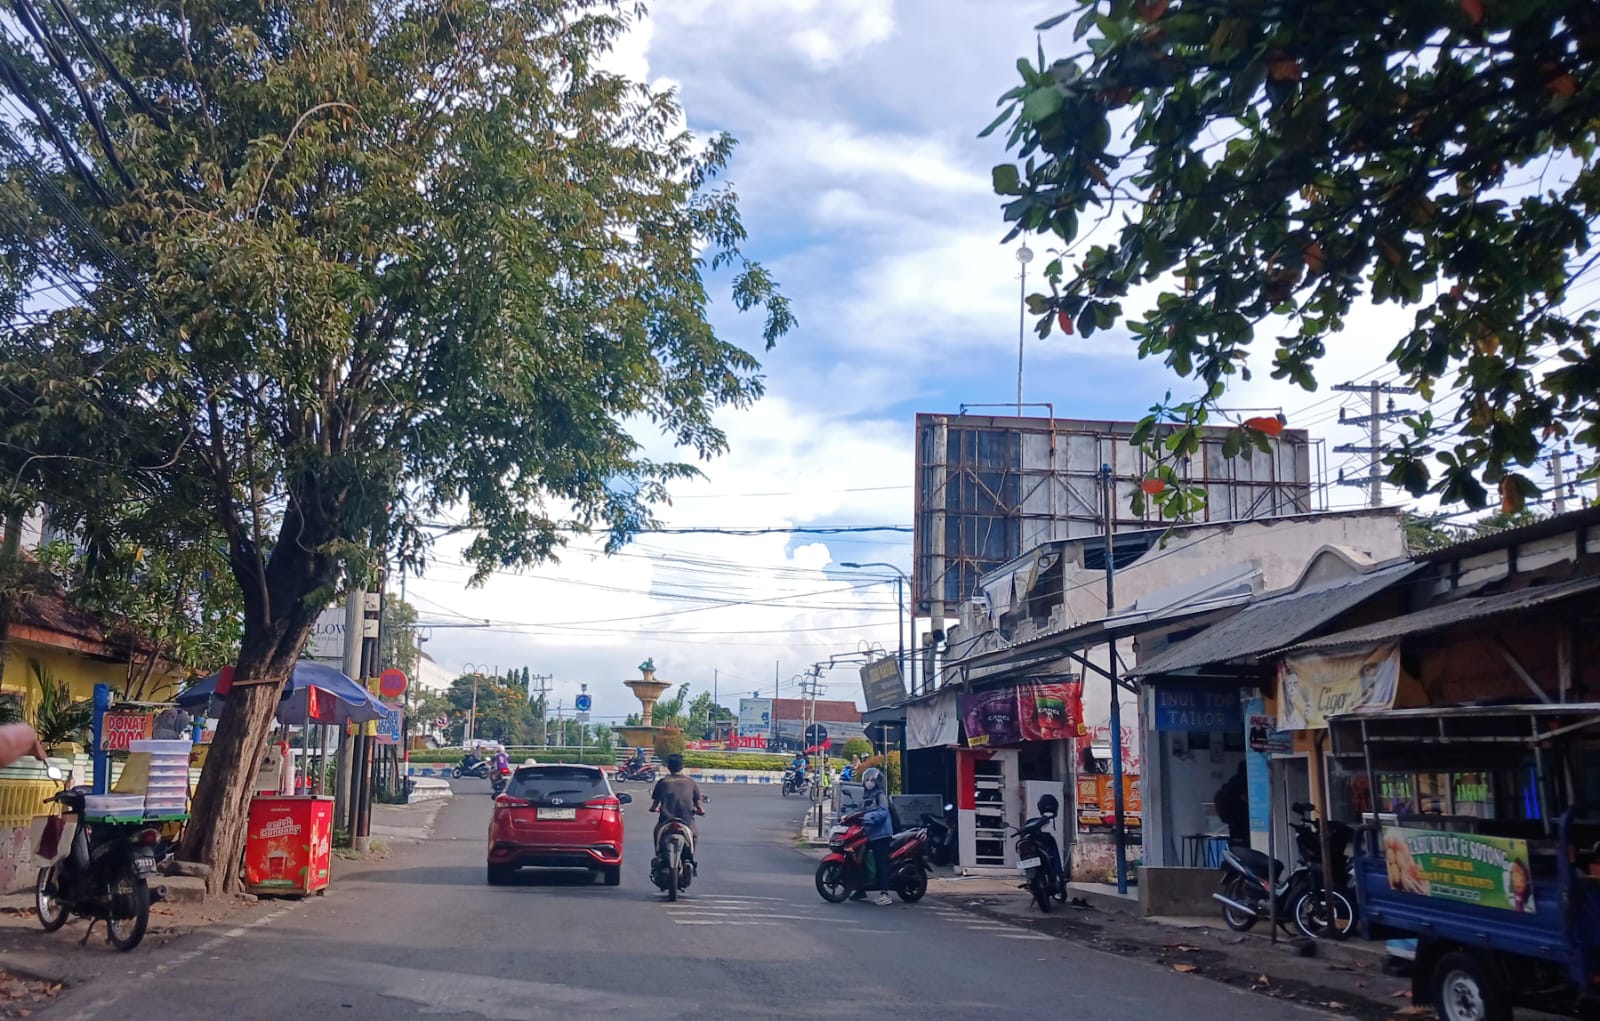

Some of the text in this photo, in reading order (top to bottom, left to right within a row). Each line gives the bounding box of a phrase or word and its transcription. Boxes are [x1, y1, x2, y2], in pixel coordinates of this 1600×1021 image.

[108, 715, 147, 730] DONAT
[1167, 710, 1225, 726] TAILOR
[729, 731, 767, 749] bank
[1430, 836, 1459, 856] BULAT
[1469, 840, 1510, 870] SOTONG
